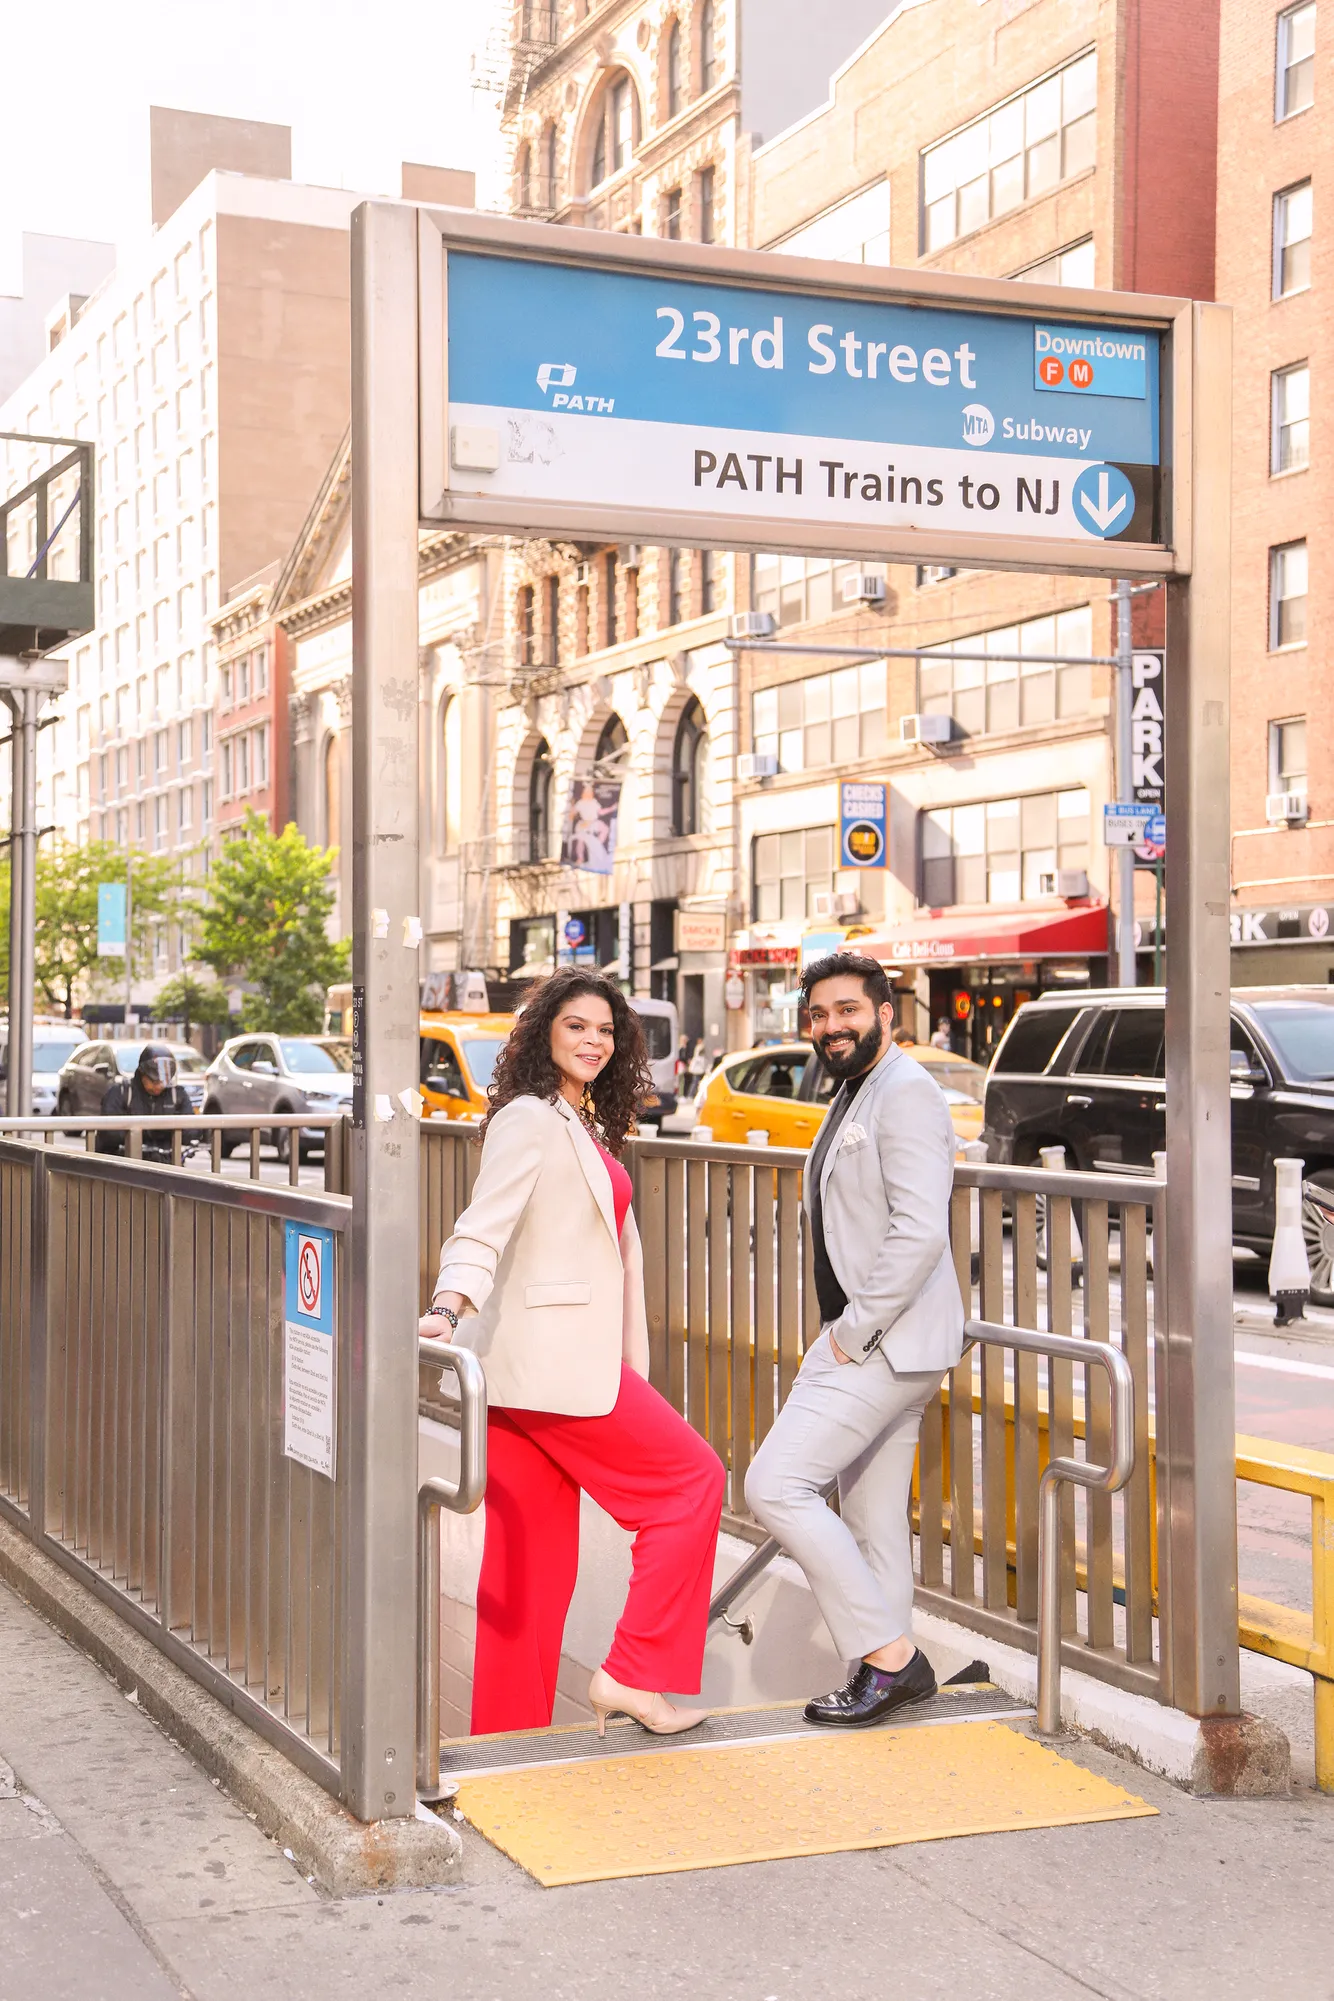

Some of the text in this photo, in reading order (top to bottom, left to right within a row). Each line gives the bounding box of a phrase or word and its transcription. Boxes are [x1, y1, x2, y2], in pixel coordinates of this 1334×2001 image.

[655, 306, 977, 390] 23rd Street
[1035, 330, 1146, 361] Downtown
[1046, 363, 1089, 383] F M
[552, 393, 616, 413] PATH
[962, 412, 1093, 451] MTA Subway
[694, 449, 1060, 516] PATH Trains to NJ
[1131, 654, 1164, 787] PARK
